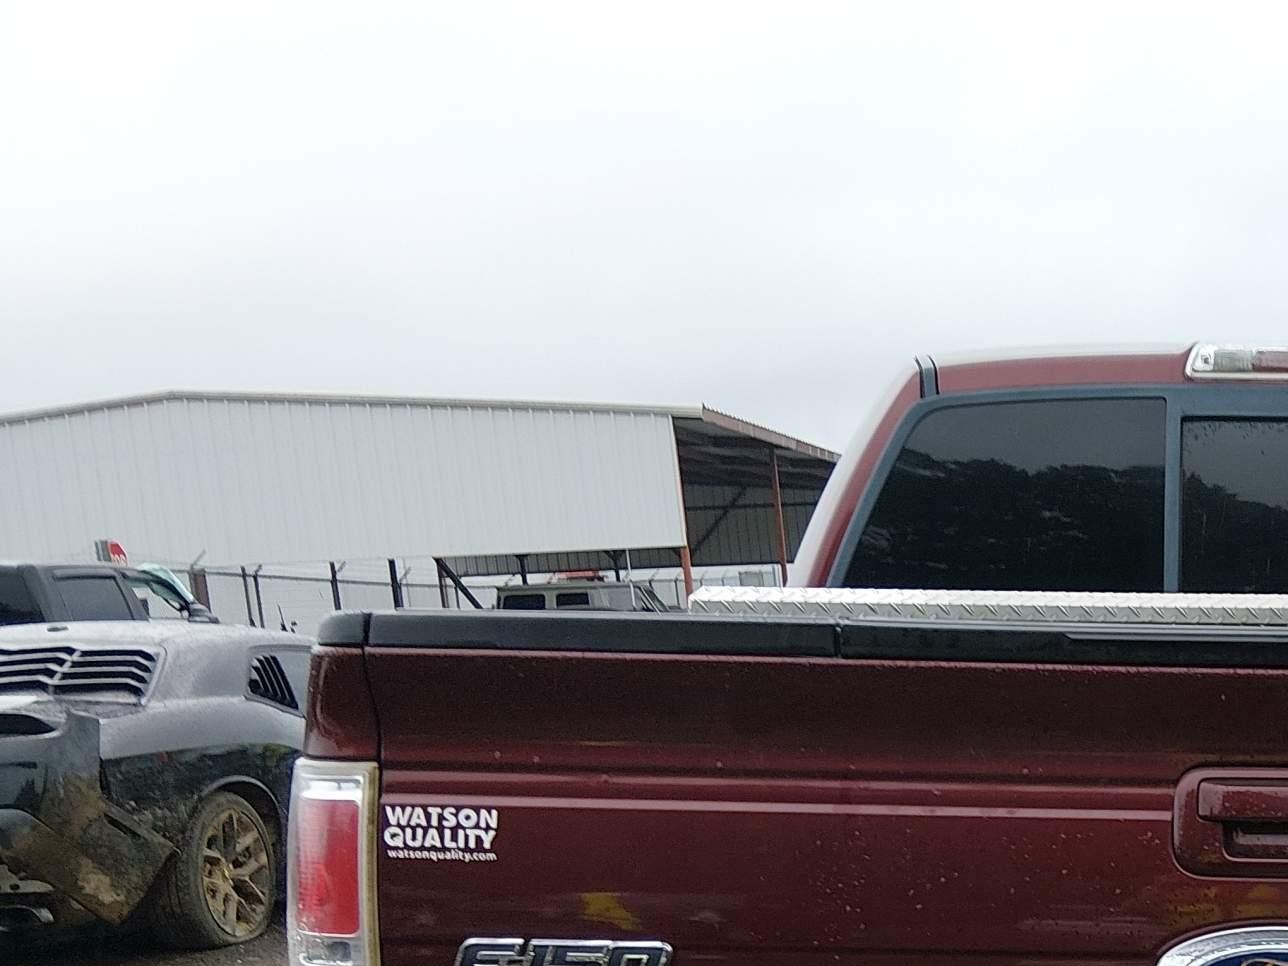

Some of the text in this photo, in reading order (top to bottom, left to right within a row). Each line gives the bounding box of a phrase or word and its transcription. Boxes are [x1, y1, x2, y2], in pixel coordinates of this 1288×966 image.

[384, 805, 498, 829] WATSON
[383, 826, 497, 849] QUALITY
[387, 848, 498, 863] watsonquality.com
